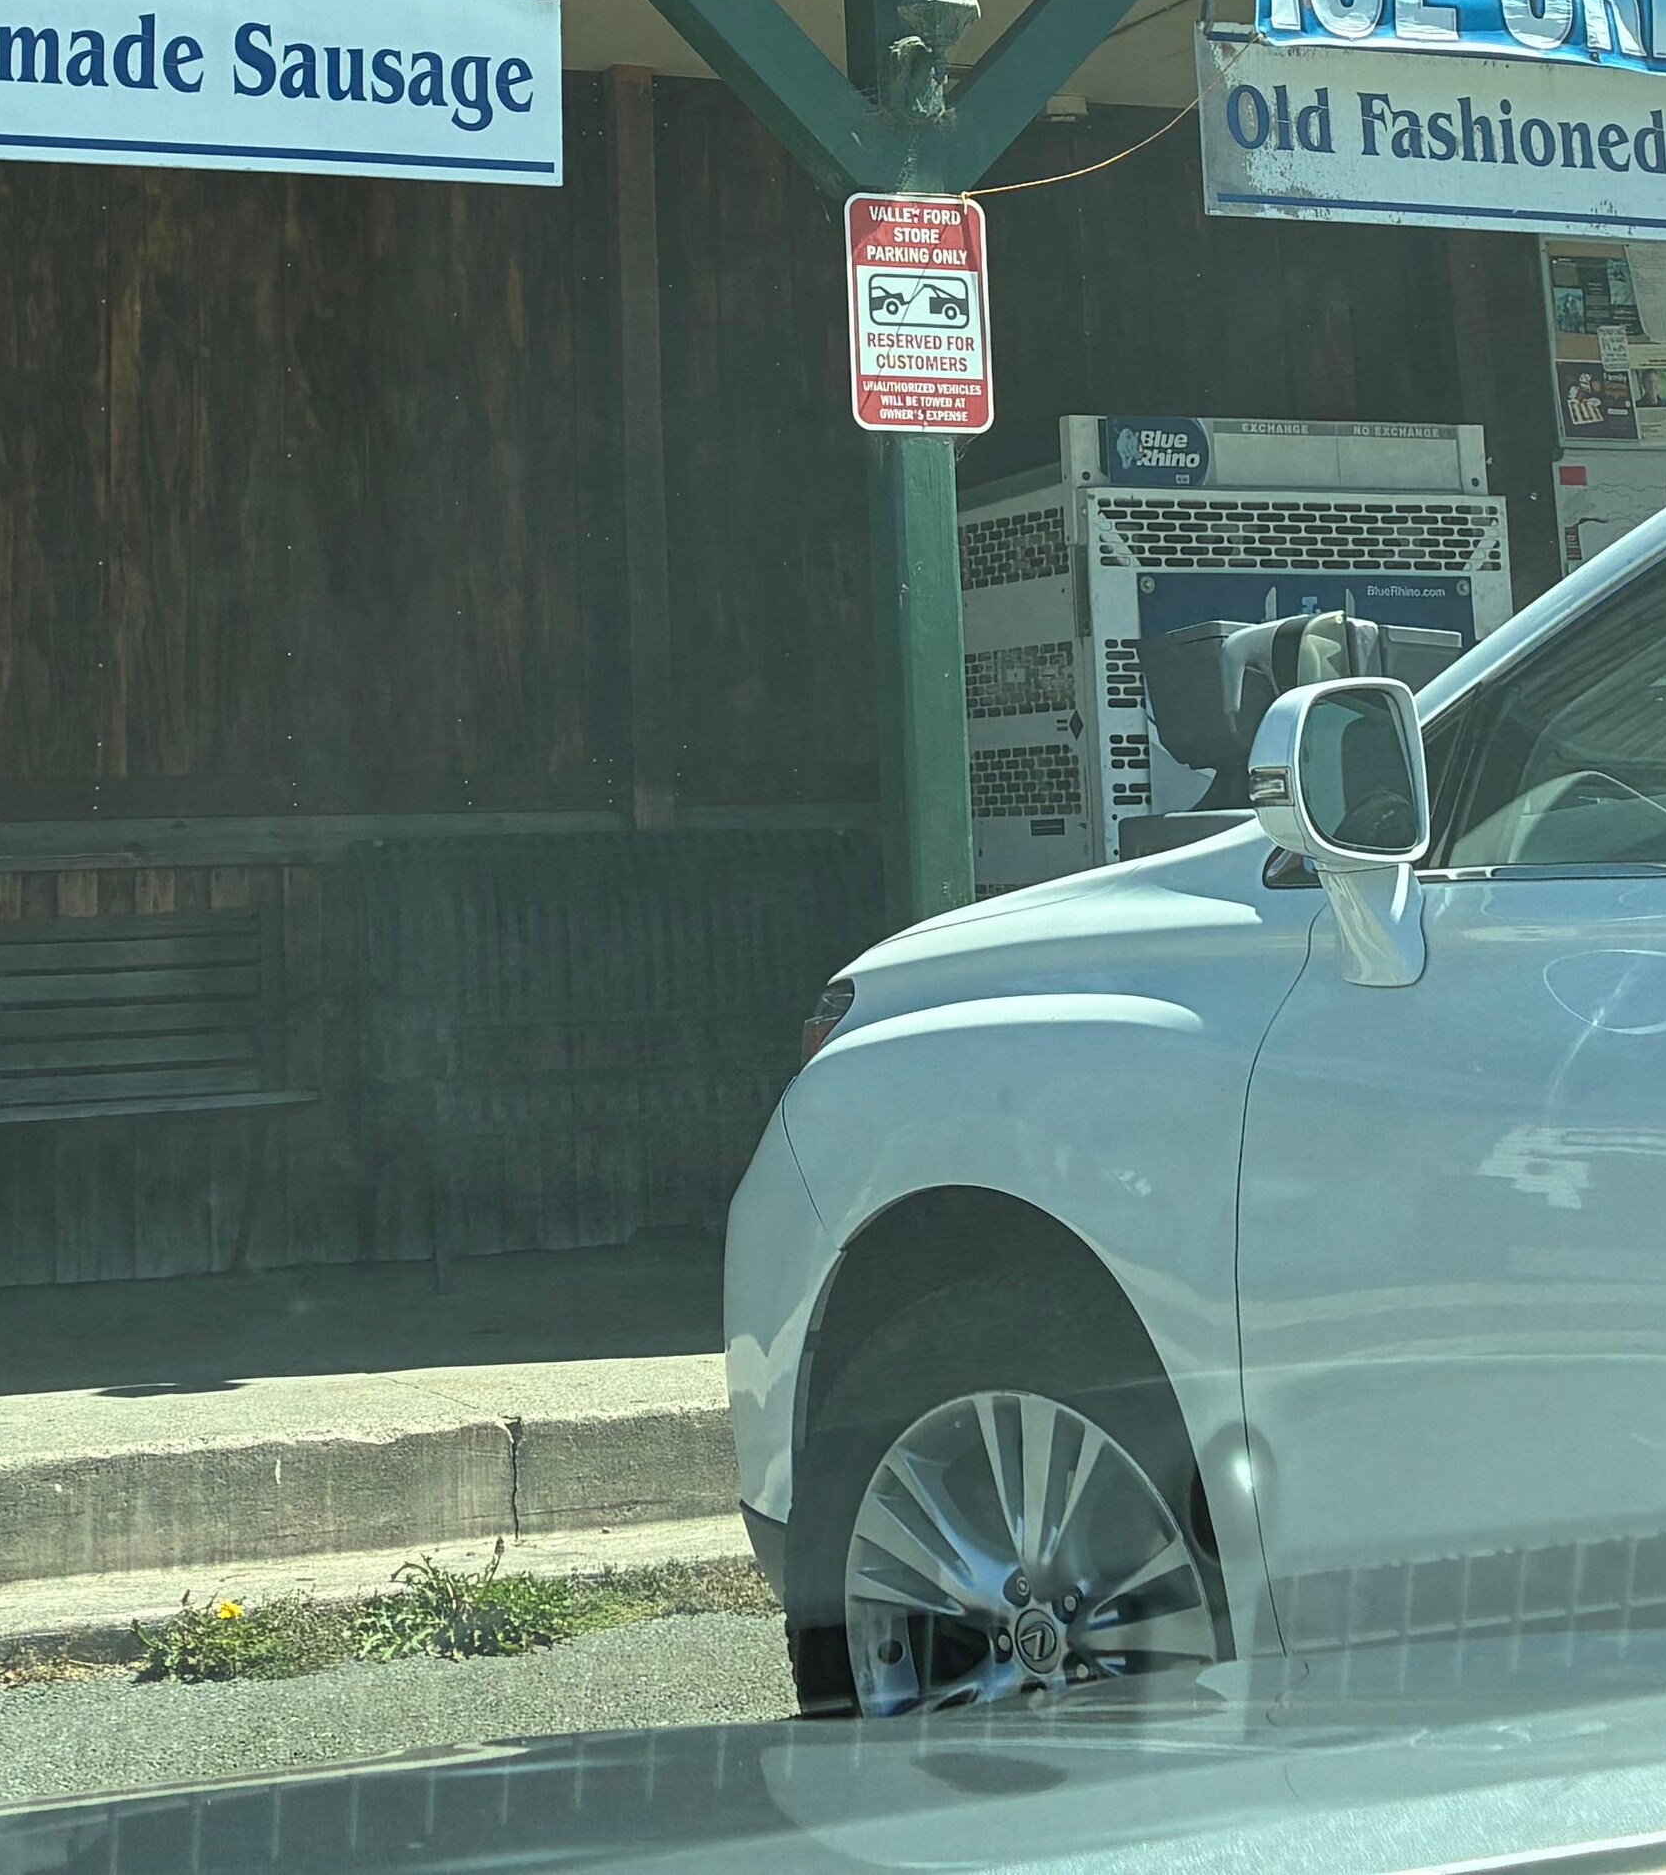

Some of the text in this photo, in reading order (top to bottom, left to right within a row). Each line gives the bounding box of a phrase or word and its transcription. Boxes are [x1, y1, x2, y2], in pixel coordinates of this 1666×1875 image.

[232, 22, 535, 133] Sausage
[1226, 82, 1335, 156] Old
[869, 205, 961, 225] VALLEY FORD
[893, 226, 940, 244] STORE
[866, 245, 968, 265] PARKING ONLY
[867, 332, 975, 351] RESERVED FOR
[876, 353, 968, 372] CUSTOMERS
[862, 380, 983, 396] UNAUTHORIZED VEHICLES
[879, 395, 966, 408] WILL BE TOWED AT
[879, 408, 969, 422] OWNER'S EXPENSE
[1241, 422, 1310, 435] EXCHANGE
[1353, 426, 1441, 439] NO EXCHANGE
[1140, 430, 1188, 448] Blue
[1136, 448, 1200, 468] Rhino
[1367, 585, 1446, 598] BlueRhino.com
